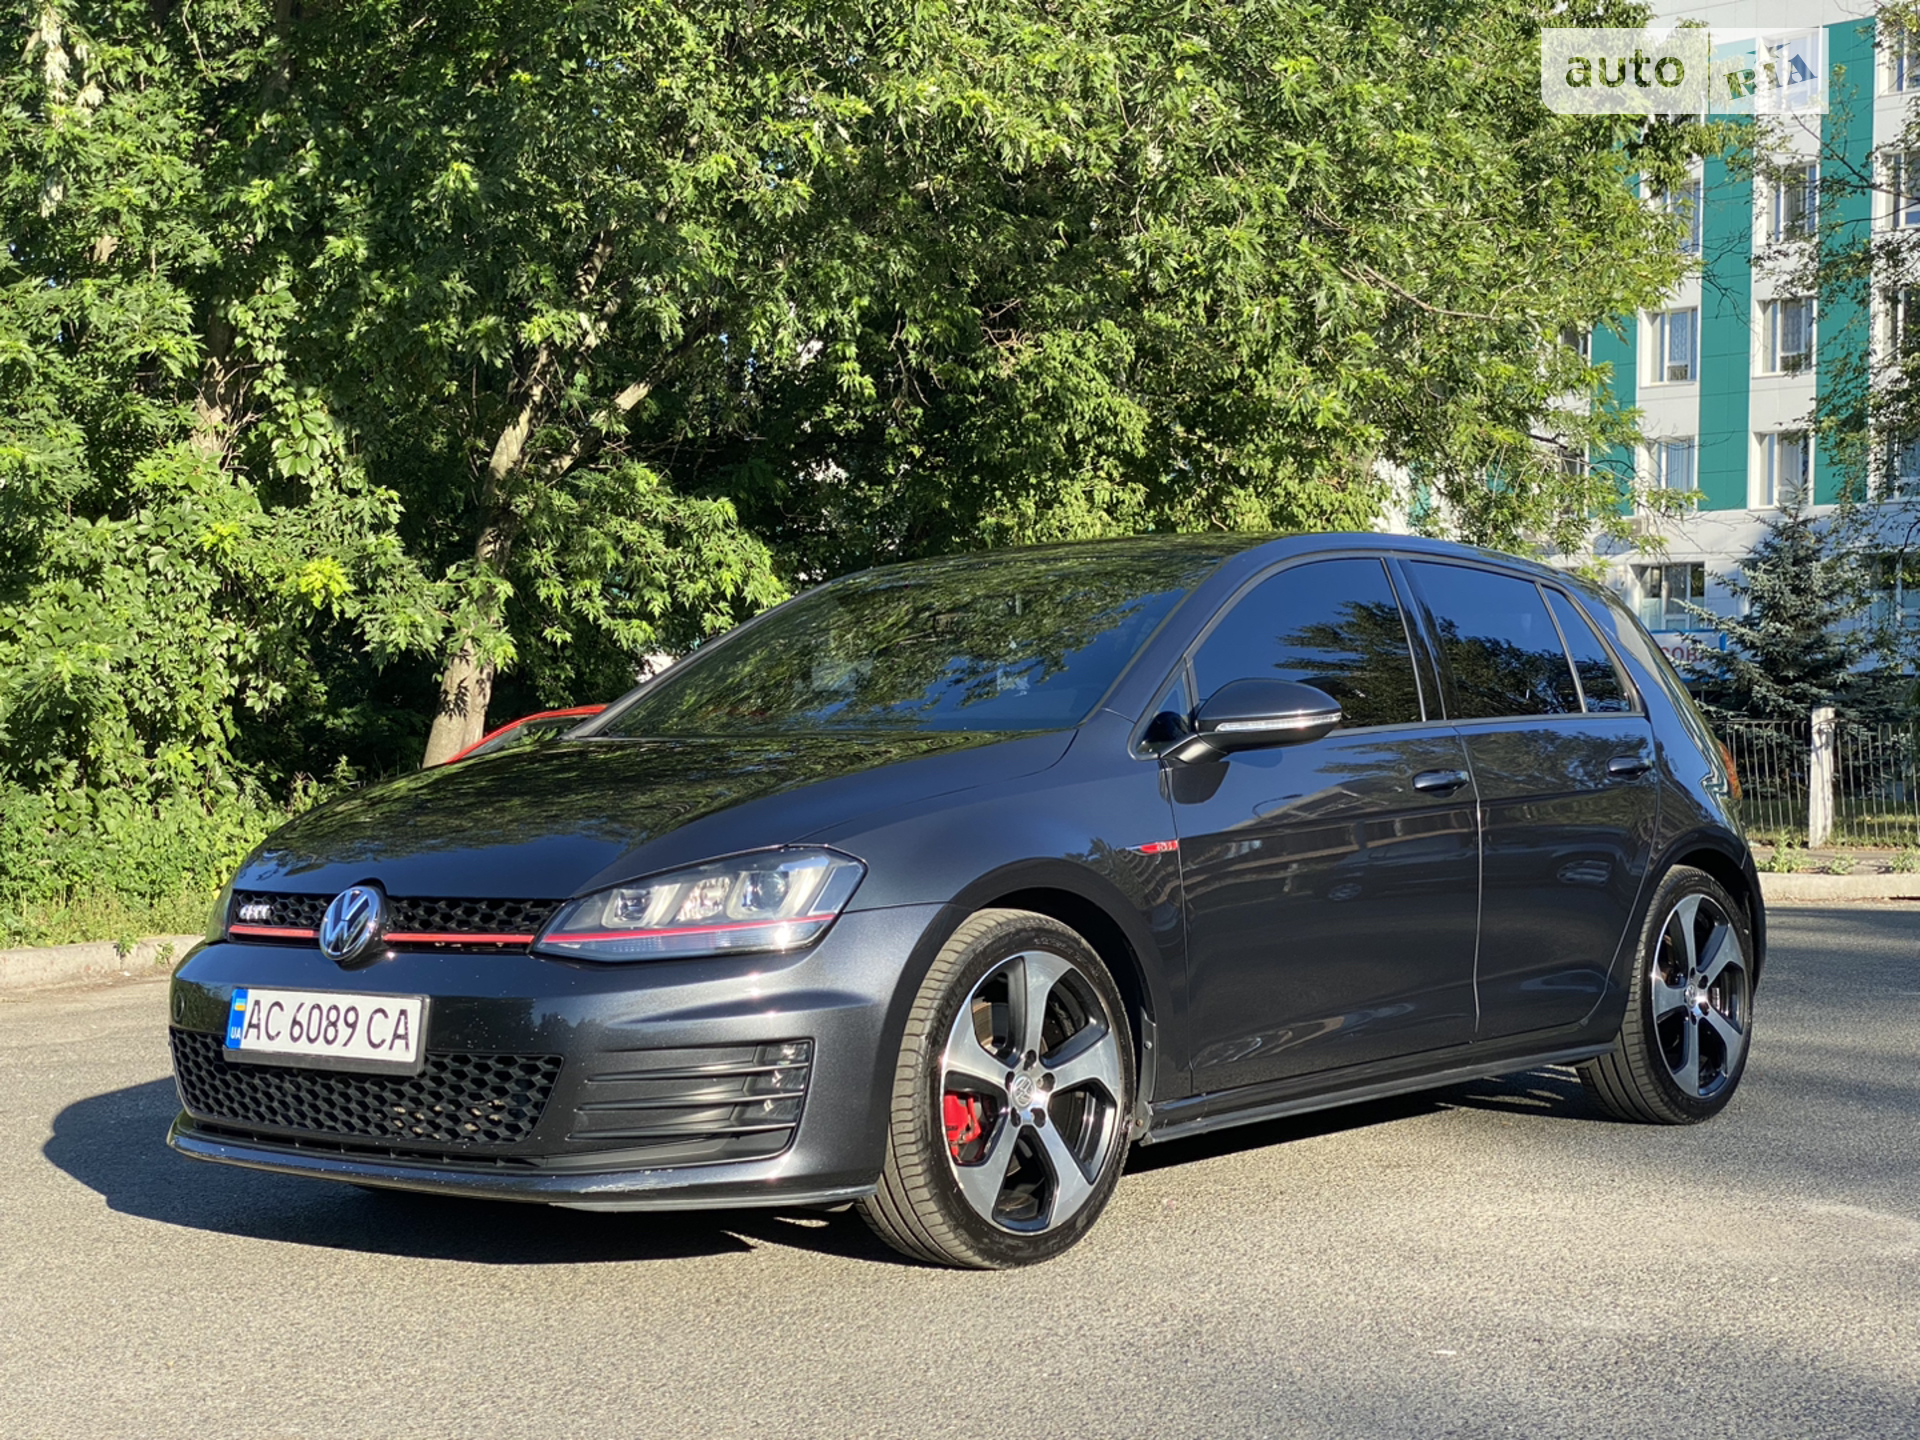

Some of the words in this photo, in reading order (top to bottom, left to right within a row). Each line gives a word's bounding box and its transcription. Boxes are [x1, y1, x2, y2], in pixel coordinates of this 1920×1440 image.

[230, 1026, 241, 1040] UA
[243, 999, 284, 1042] AC
[289, 1002, 360, 1048] 6089
[366, 1007, 410, 1052] CA
